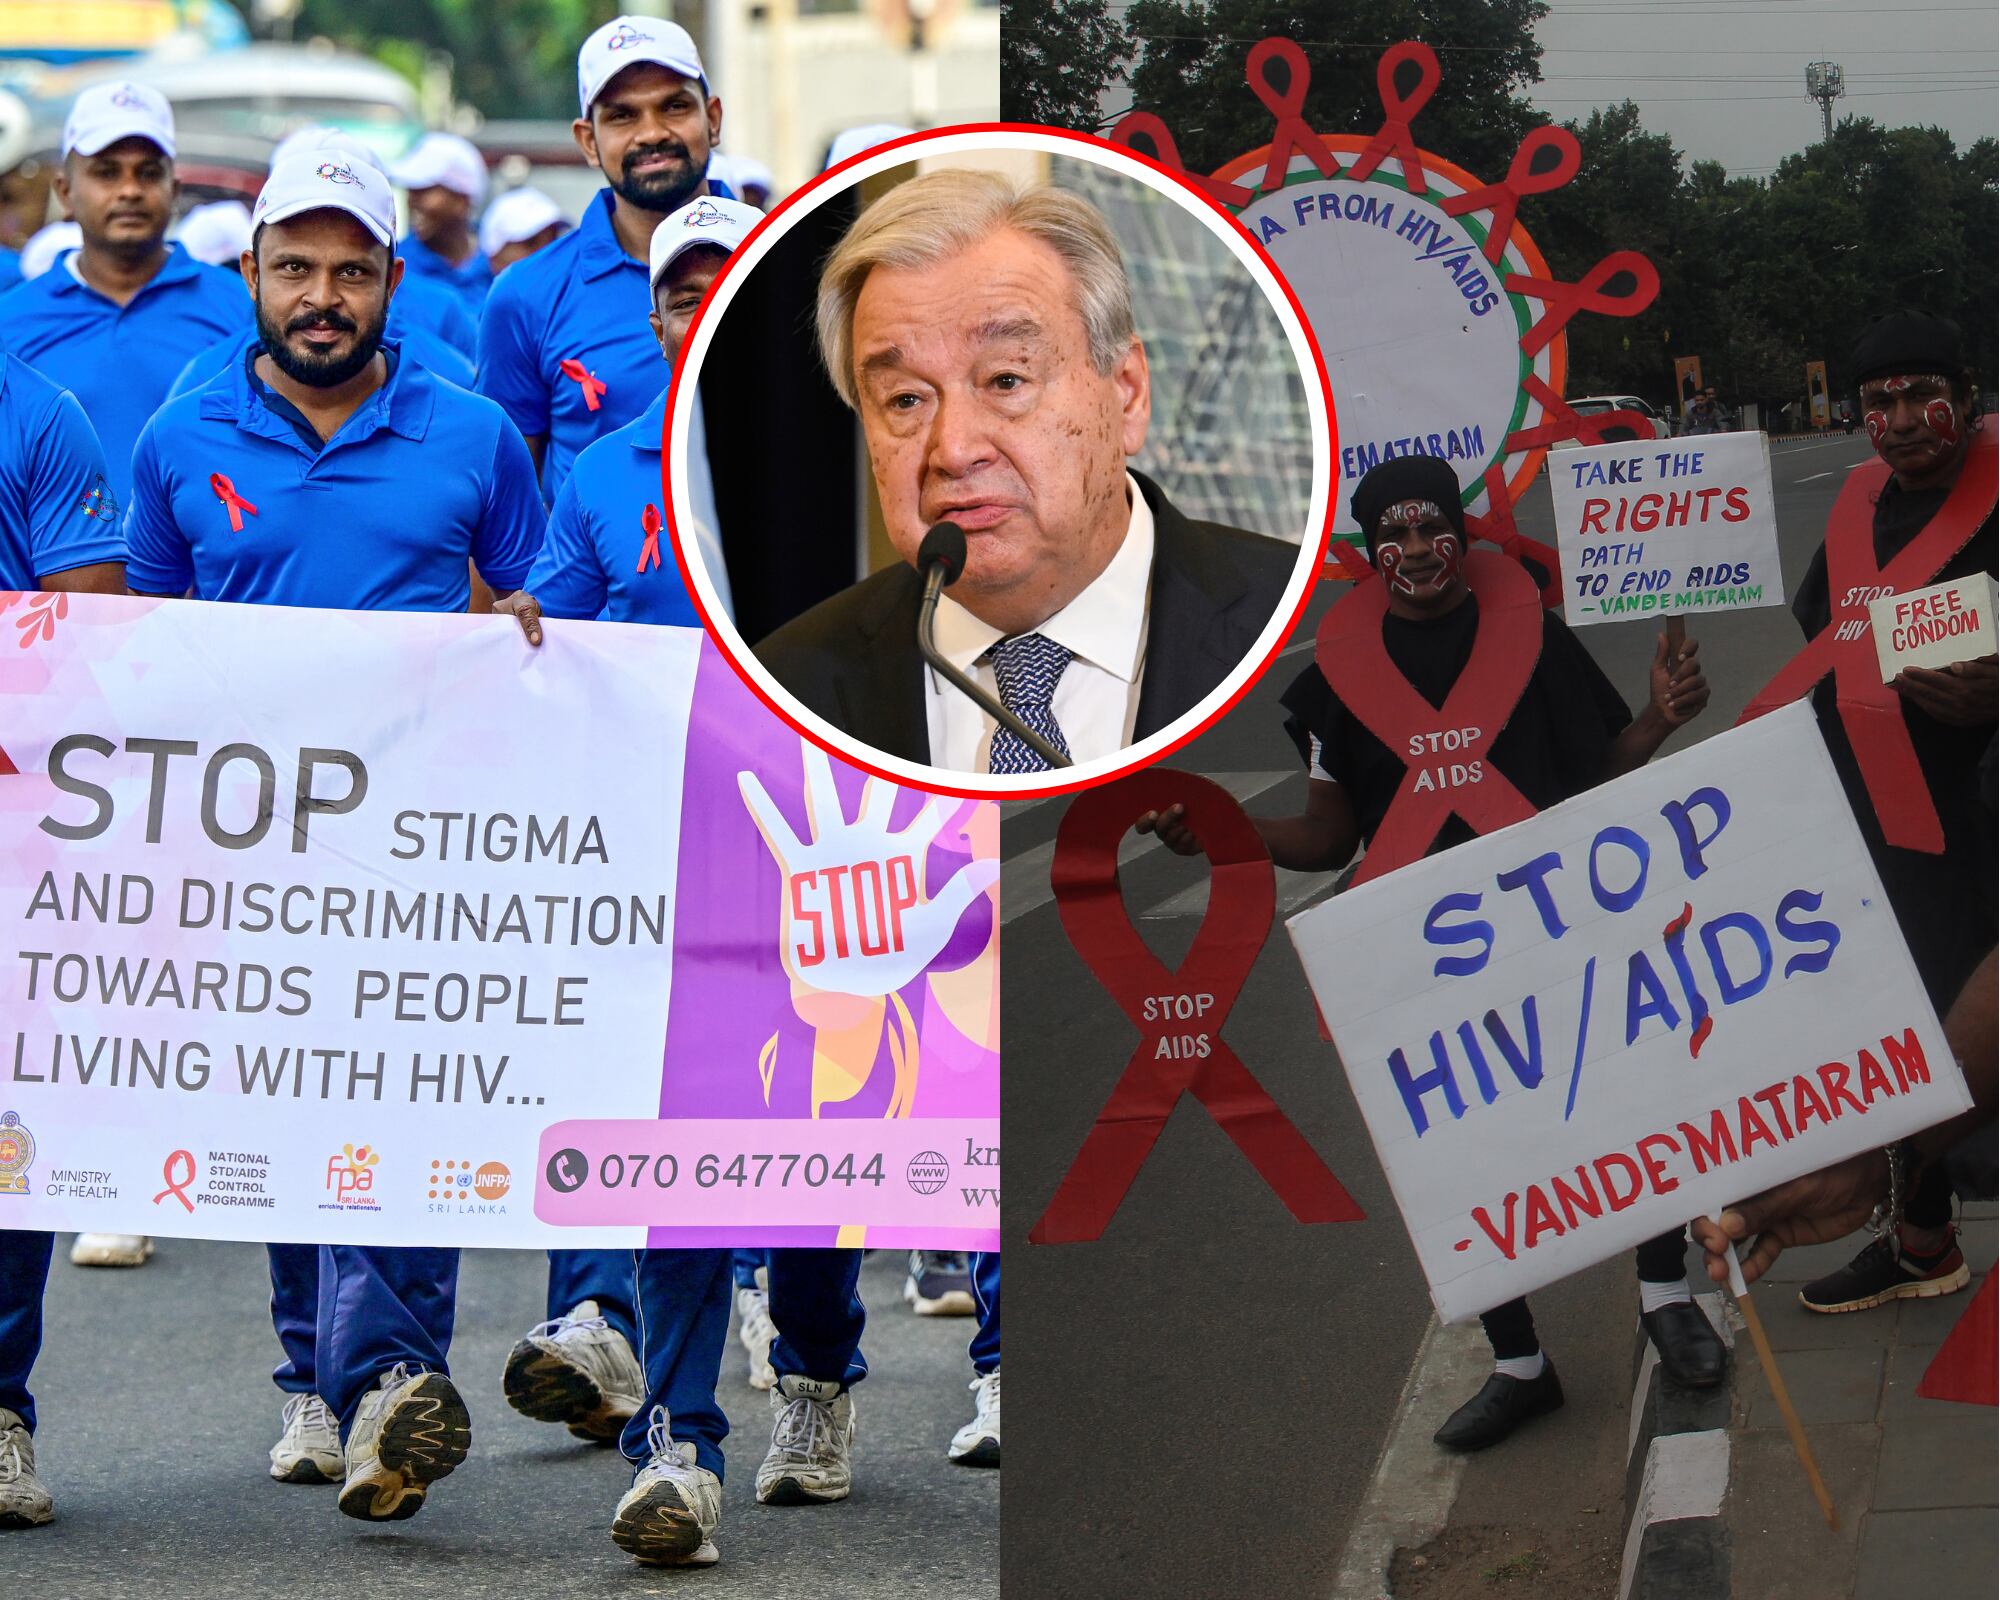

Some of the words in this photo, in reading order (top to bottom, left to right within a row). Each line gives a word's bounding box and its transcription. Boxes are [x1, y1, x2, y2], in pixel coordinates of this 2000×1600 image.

[1249, 215, 1287, 247] A
[1293, 193, 1395, 229] FROM
[1396, 208, 1499, 317] HIV/AIDS
[1338, 424, 1485, 479] EMATARAM
[1571, 457, 1644, 489] TAKE
[1655, 452, 1705, 479] THE
[1579, 486, 1751, 535] RIGHTS
[1580, 542, 1644, 568] PATH
[1576, 573, 1609, 597] TO
[1619, 569, 1672, 594] END
[1686, 562, 1750, 588] AIDS
[1895, 589, 1962, 625] FREE
[1834, 619, 1871, 641] HIV
[1892, 608, 1980, 652] CONDOM
[1409, 726, 1481, 756] STOP
[1413, 760, 1484, 793] AIDS
[38, 733, 369, 854] STOP
[390, 810, 610, 865] STIGMA
[1424, 787, 1731, 978] STOP
[25, 871, 154, 925] AND
[179, 878, 667, 946] DISCRIMINATION
[790, 855, 918, 967] STOP
[18, 951, 312, 1016] TOWARDS
[354, 970, 589, 1026] PEOPLE
[1143, 993, 1214, 1022] STOP
[1386, 889, 1842, 1139] HIV/AIDS
[1154, 1033, 1212, 1060] AIDS
[13, 1032, 211, 1092] LIVING
[235, 1044, 385, 1101] WITH
[410, 1053, 545, 1106] HIV...
[208, 1151, 271, 1165] NATIONAL
[209, 1166, 267, 1179] STD/AIDS
[600, 1154, 679, 1188] 070
[695, 1152, 885, 1188] 6477044
[911, 1168, 945, 1177] www
[46, 1184, 65, 1197] OF
[69, 1185, 118, 1199] HEALTH
[51, 1169, 112, 1184] MINISTRY
[208, 1180, 266, 1193] CONTROL
[326, 1155, 373, 1203] fpa
[473, 1174, 511, 1188] UNFPA
[196, 1194, 276, 1208] PROGRAMME
[346, 1204, 382, 1212] relationships
[353, 1197, 376, 1205] LANKA
[428, 1203, 451, 1213] SRI
[459, 1204, 507, 1214] LANKA
[798, 1382, 823, 1394] SLN
